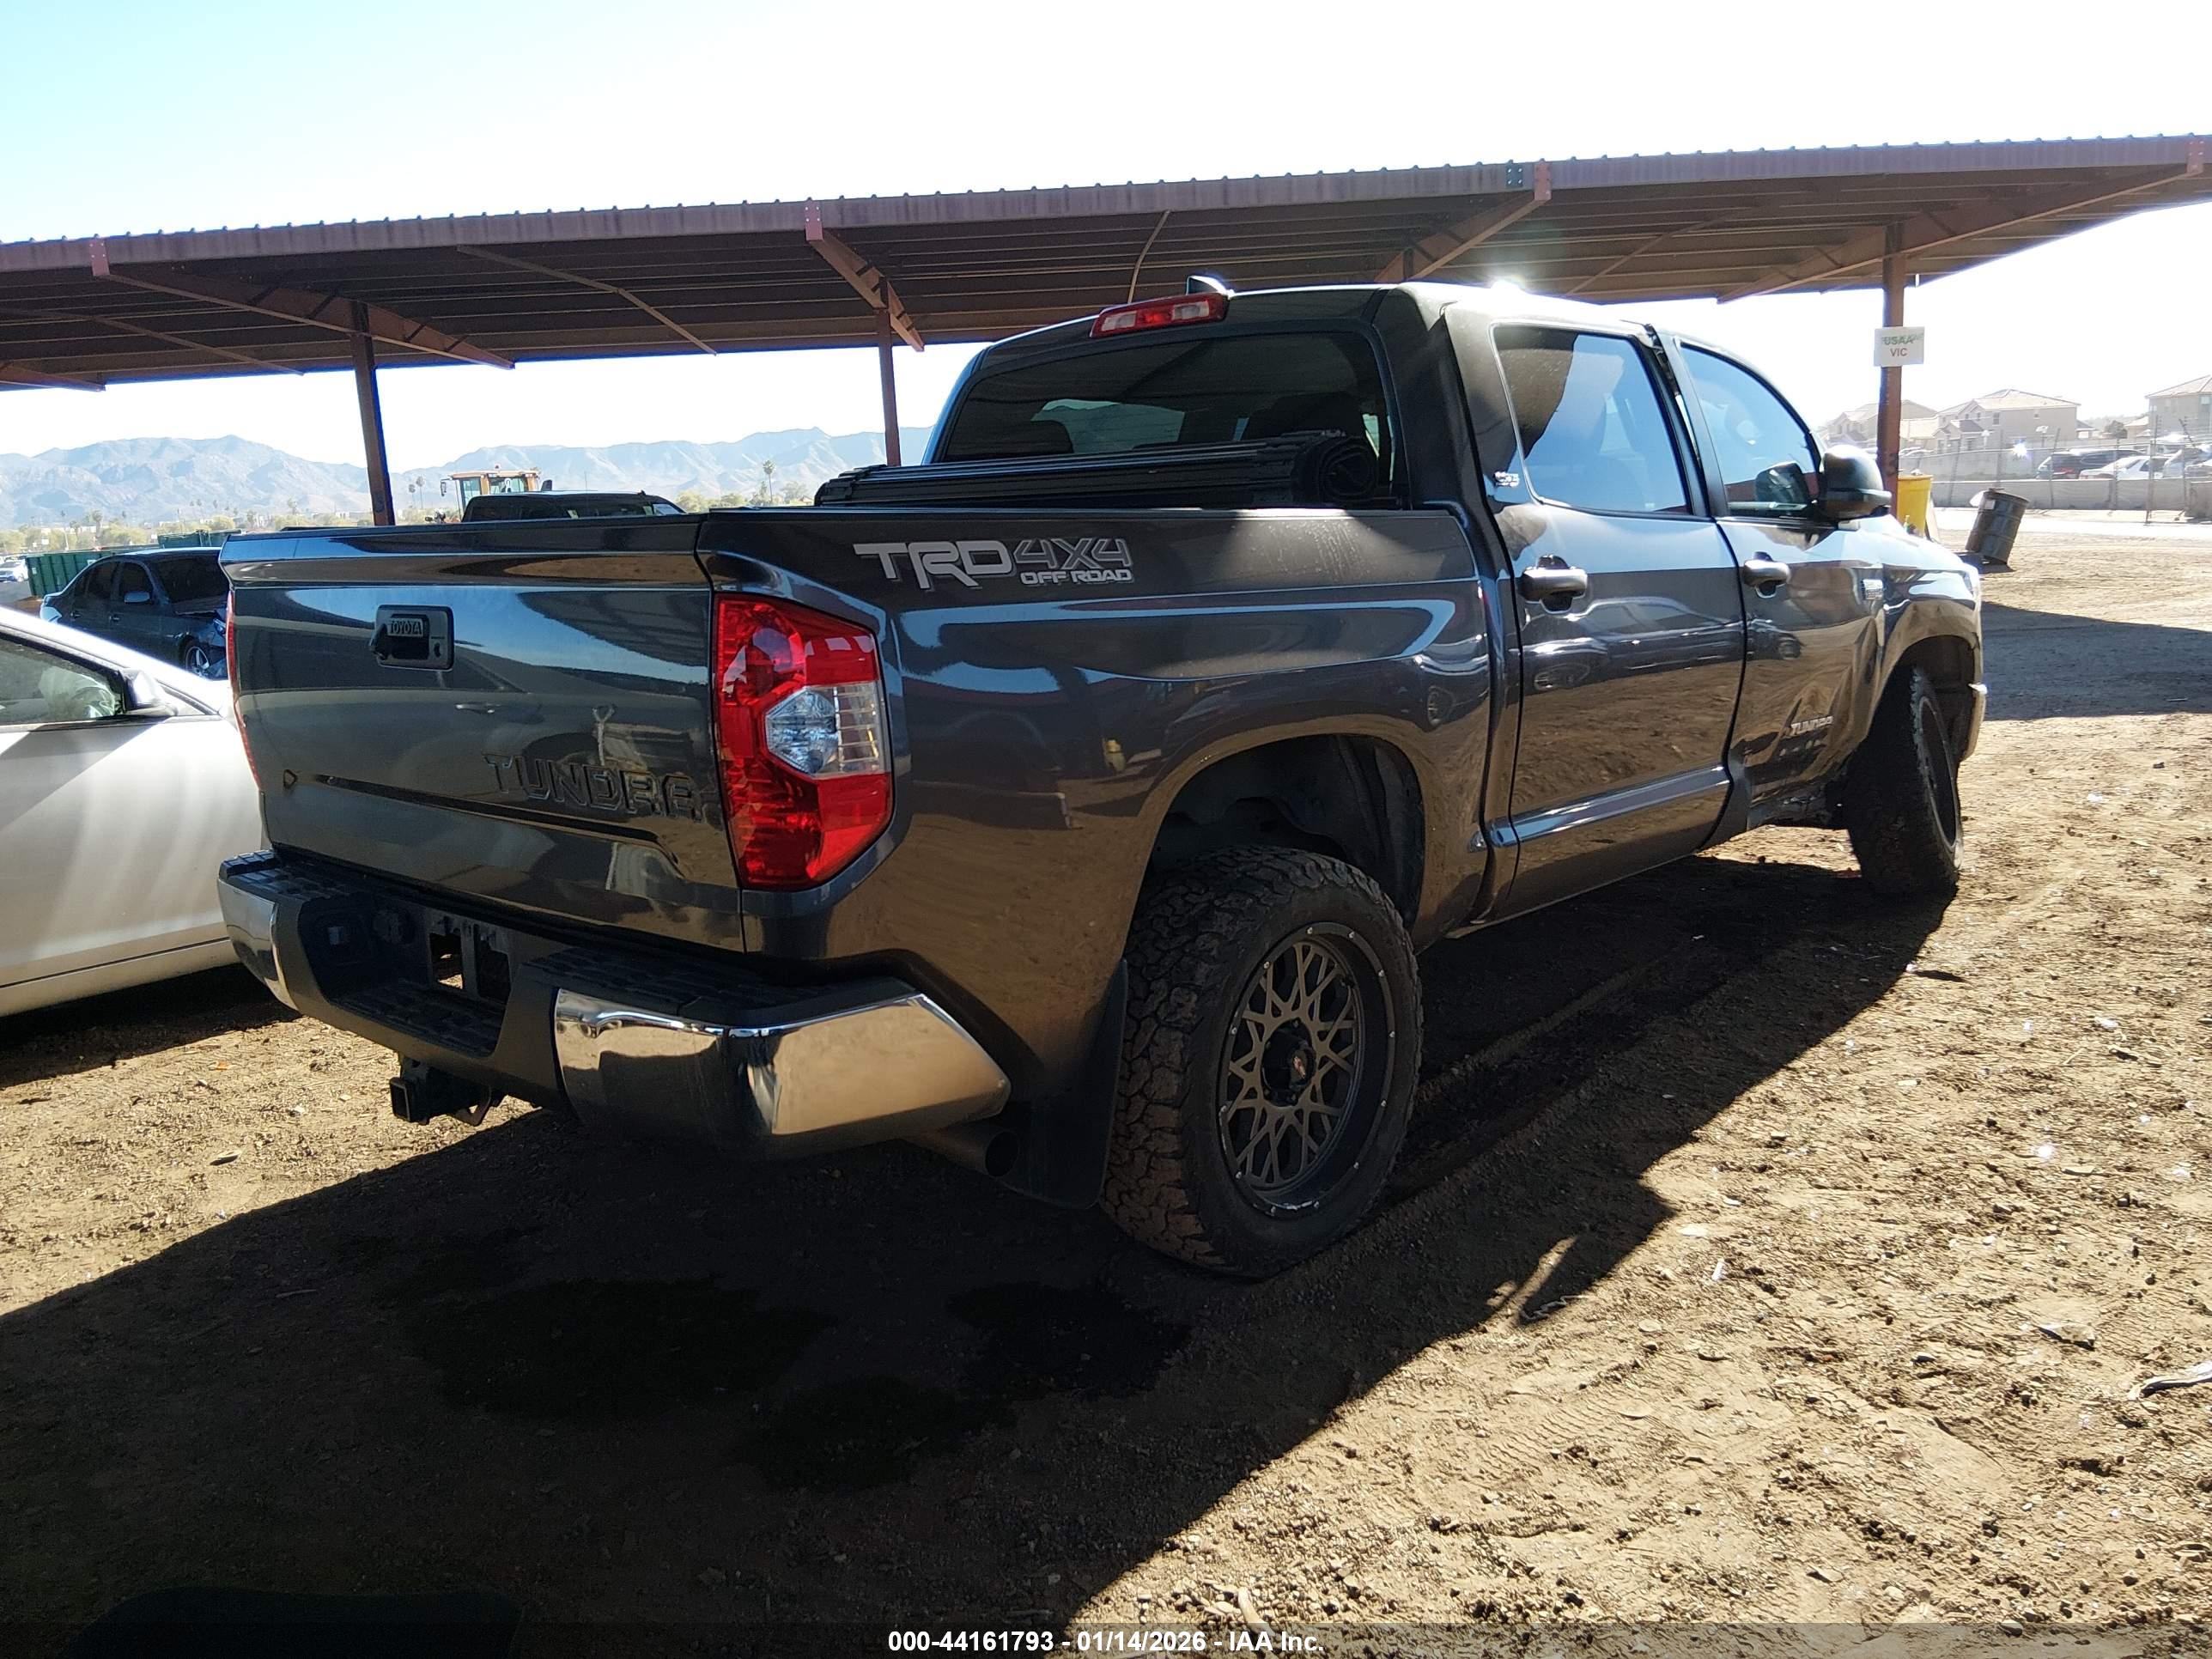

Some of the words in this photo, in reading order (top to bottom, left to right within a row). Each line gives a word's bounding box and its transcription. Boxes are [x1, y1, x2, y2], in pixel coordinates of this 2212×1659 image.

[1889, 348, 1907, 357] VIC
[853, 540, 1013, 589] TRD
[1012, 538, 1133, 569] 4X4
[1020, 570, 1066, 585] OFF
[1070, 568, 1133, 583] ROAD
[389, 619, 422, 635] TOYOTA
[482, 753, 707, 823] TUNDRA
